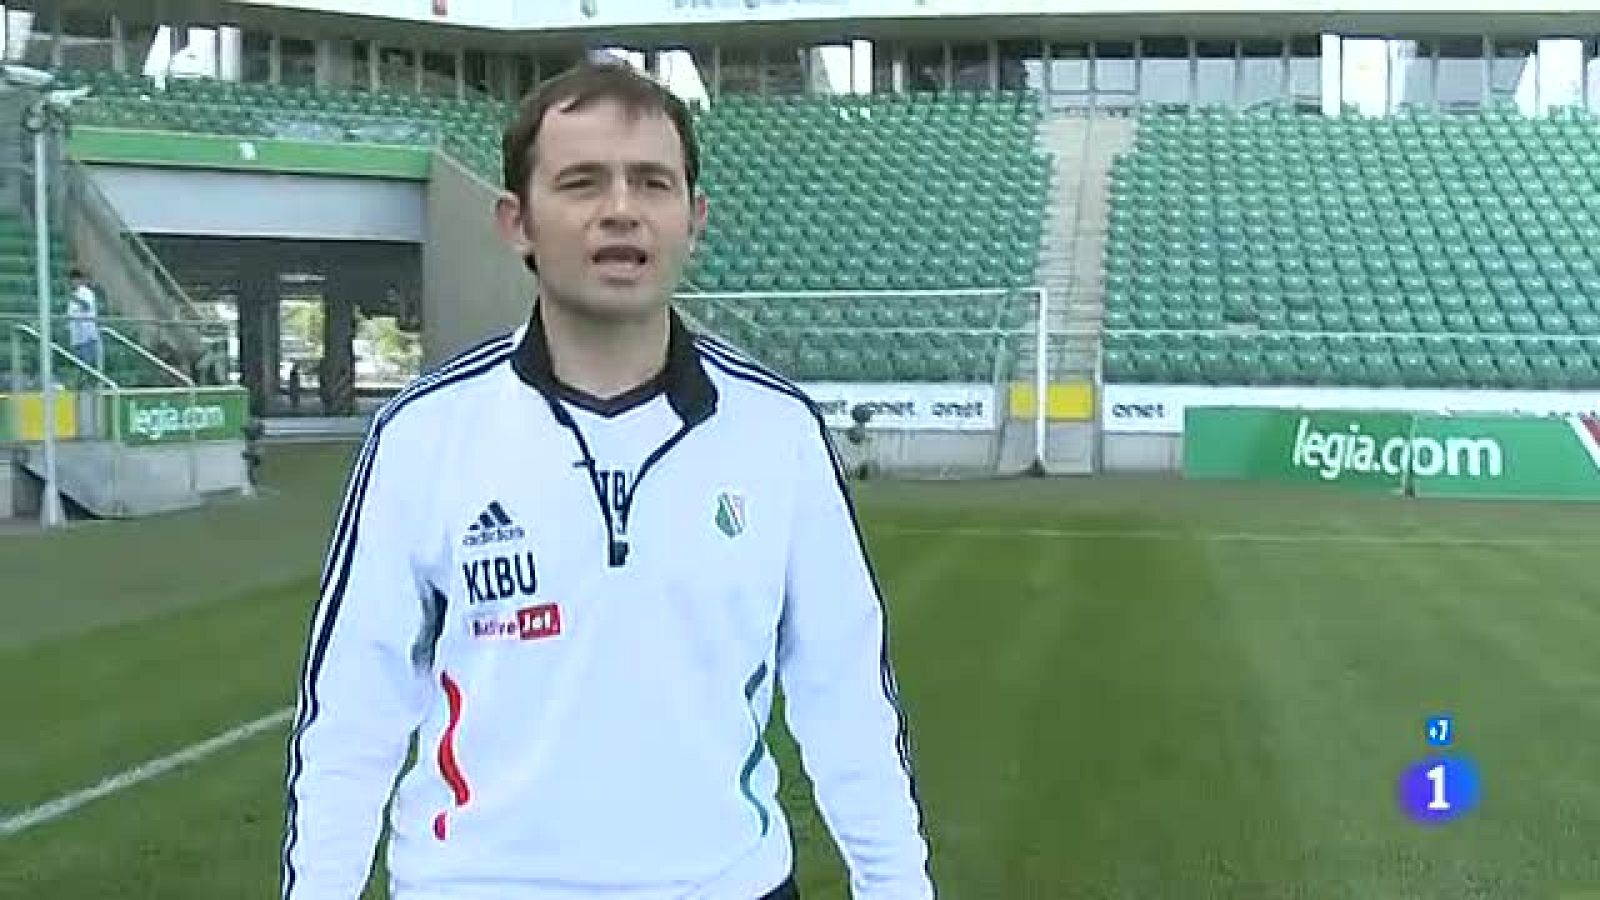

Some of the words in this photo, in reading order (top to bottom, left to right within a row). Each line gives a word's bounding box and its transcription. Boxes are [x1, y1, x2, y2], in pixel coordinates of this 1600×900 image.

[129, 400, 225, 440] legia.com
[1111, 402, 1165, 419] onet
[1292, 416, 1502, 481] legia.com
[462, 526, 526, 546] adidas
[462, 551, 538, 605] KIBU
